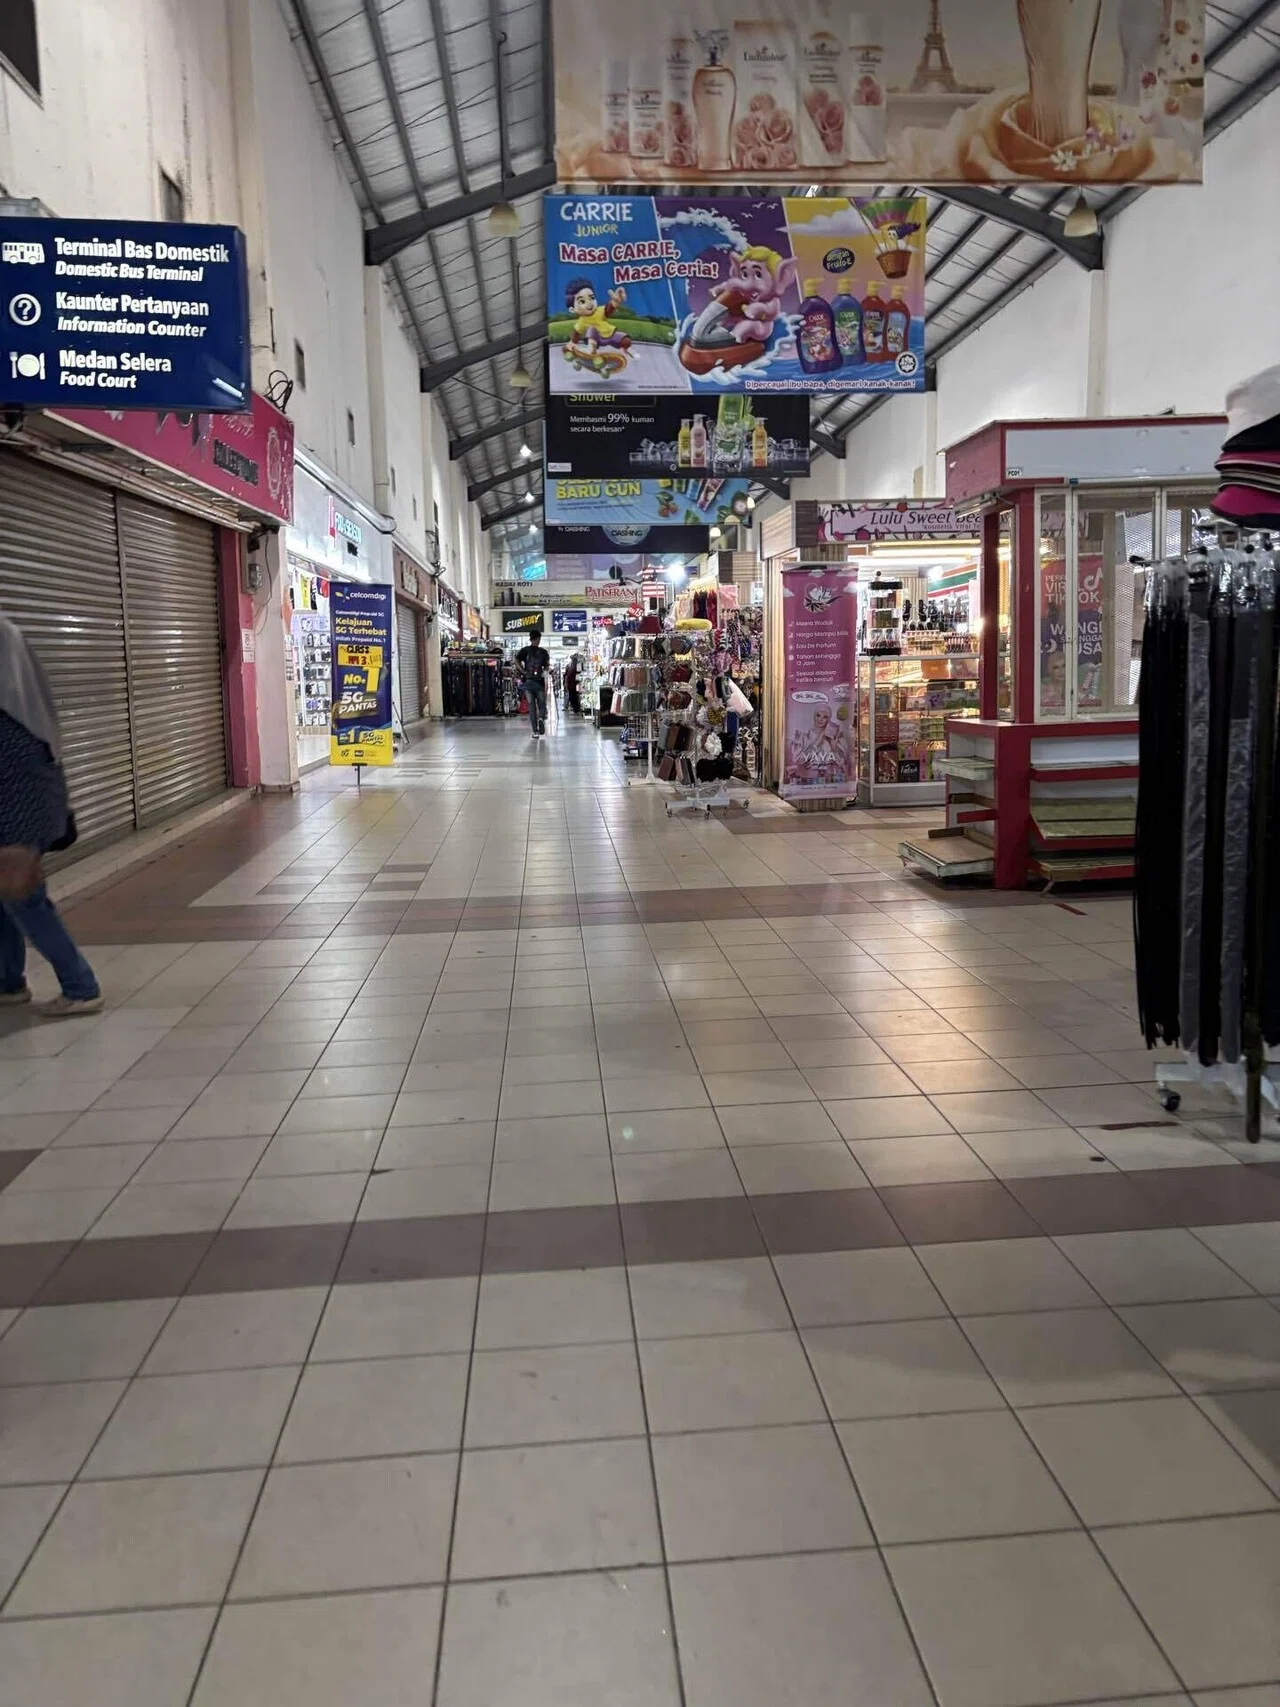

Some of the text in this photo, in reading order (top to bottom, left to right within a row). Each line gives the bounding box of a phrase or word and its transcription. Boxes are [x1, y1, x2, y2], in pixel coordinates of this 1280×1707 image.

[560, 202, 633, 221] CARRIE
[574, 224, 618, 237] JUNIOR
[55, 238, 229, 263] Terminal Bas Domestik
[560, 241, 681, 263] Masa CARRIE,
[55, 261, 204, 281] Domestic Bus Terminal
[614, 260, 719, 285] Masa Ceria!
[56, 292, 209, 318] Kaunter Pertanyaan
[58, 317, 207, 337] Information Counter
[59, 350, 172, 372] Medan Selera
[60, 371, 137, 388] Food Court
[608, 413, 630, 423] 99%
[556, 486, 600, 499] BARU
[605, 482, 641, 496] CUN
[870, 511, 904, 525] Lulu
[907, 511, 951, 524] Sweet
[611, 529, 642, 537] DASHING
[350, 592, 386, 600] celcomdigi
[335, 617, 372, 626] Kelajuan
[504, 613, 542, 631] SUBWAY
[335, 626, 387, 636] 5G Terhebat
[344, 673, 366, 685] No.
[341, 691, 364, 705] 5G
[339, 701, 378, 714] PANTAS
